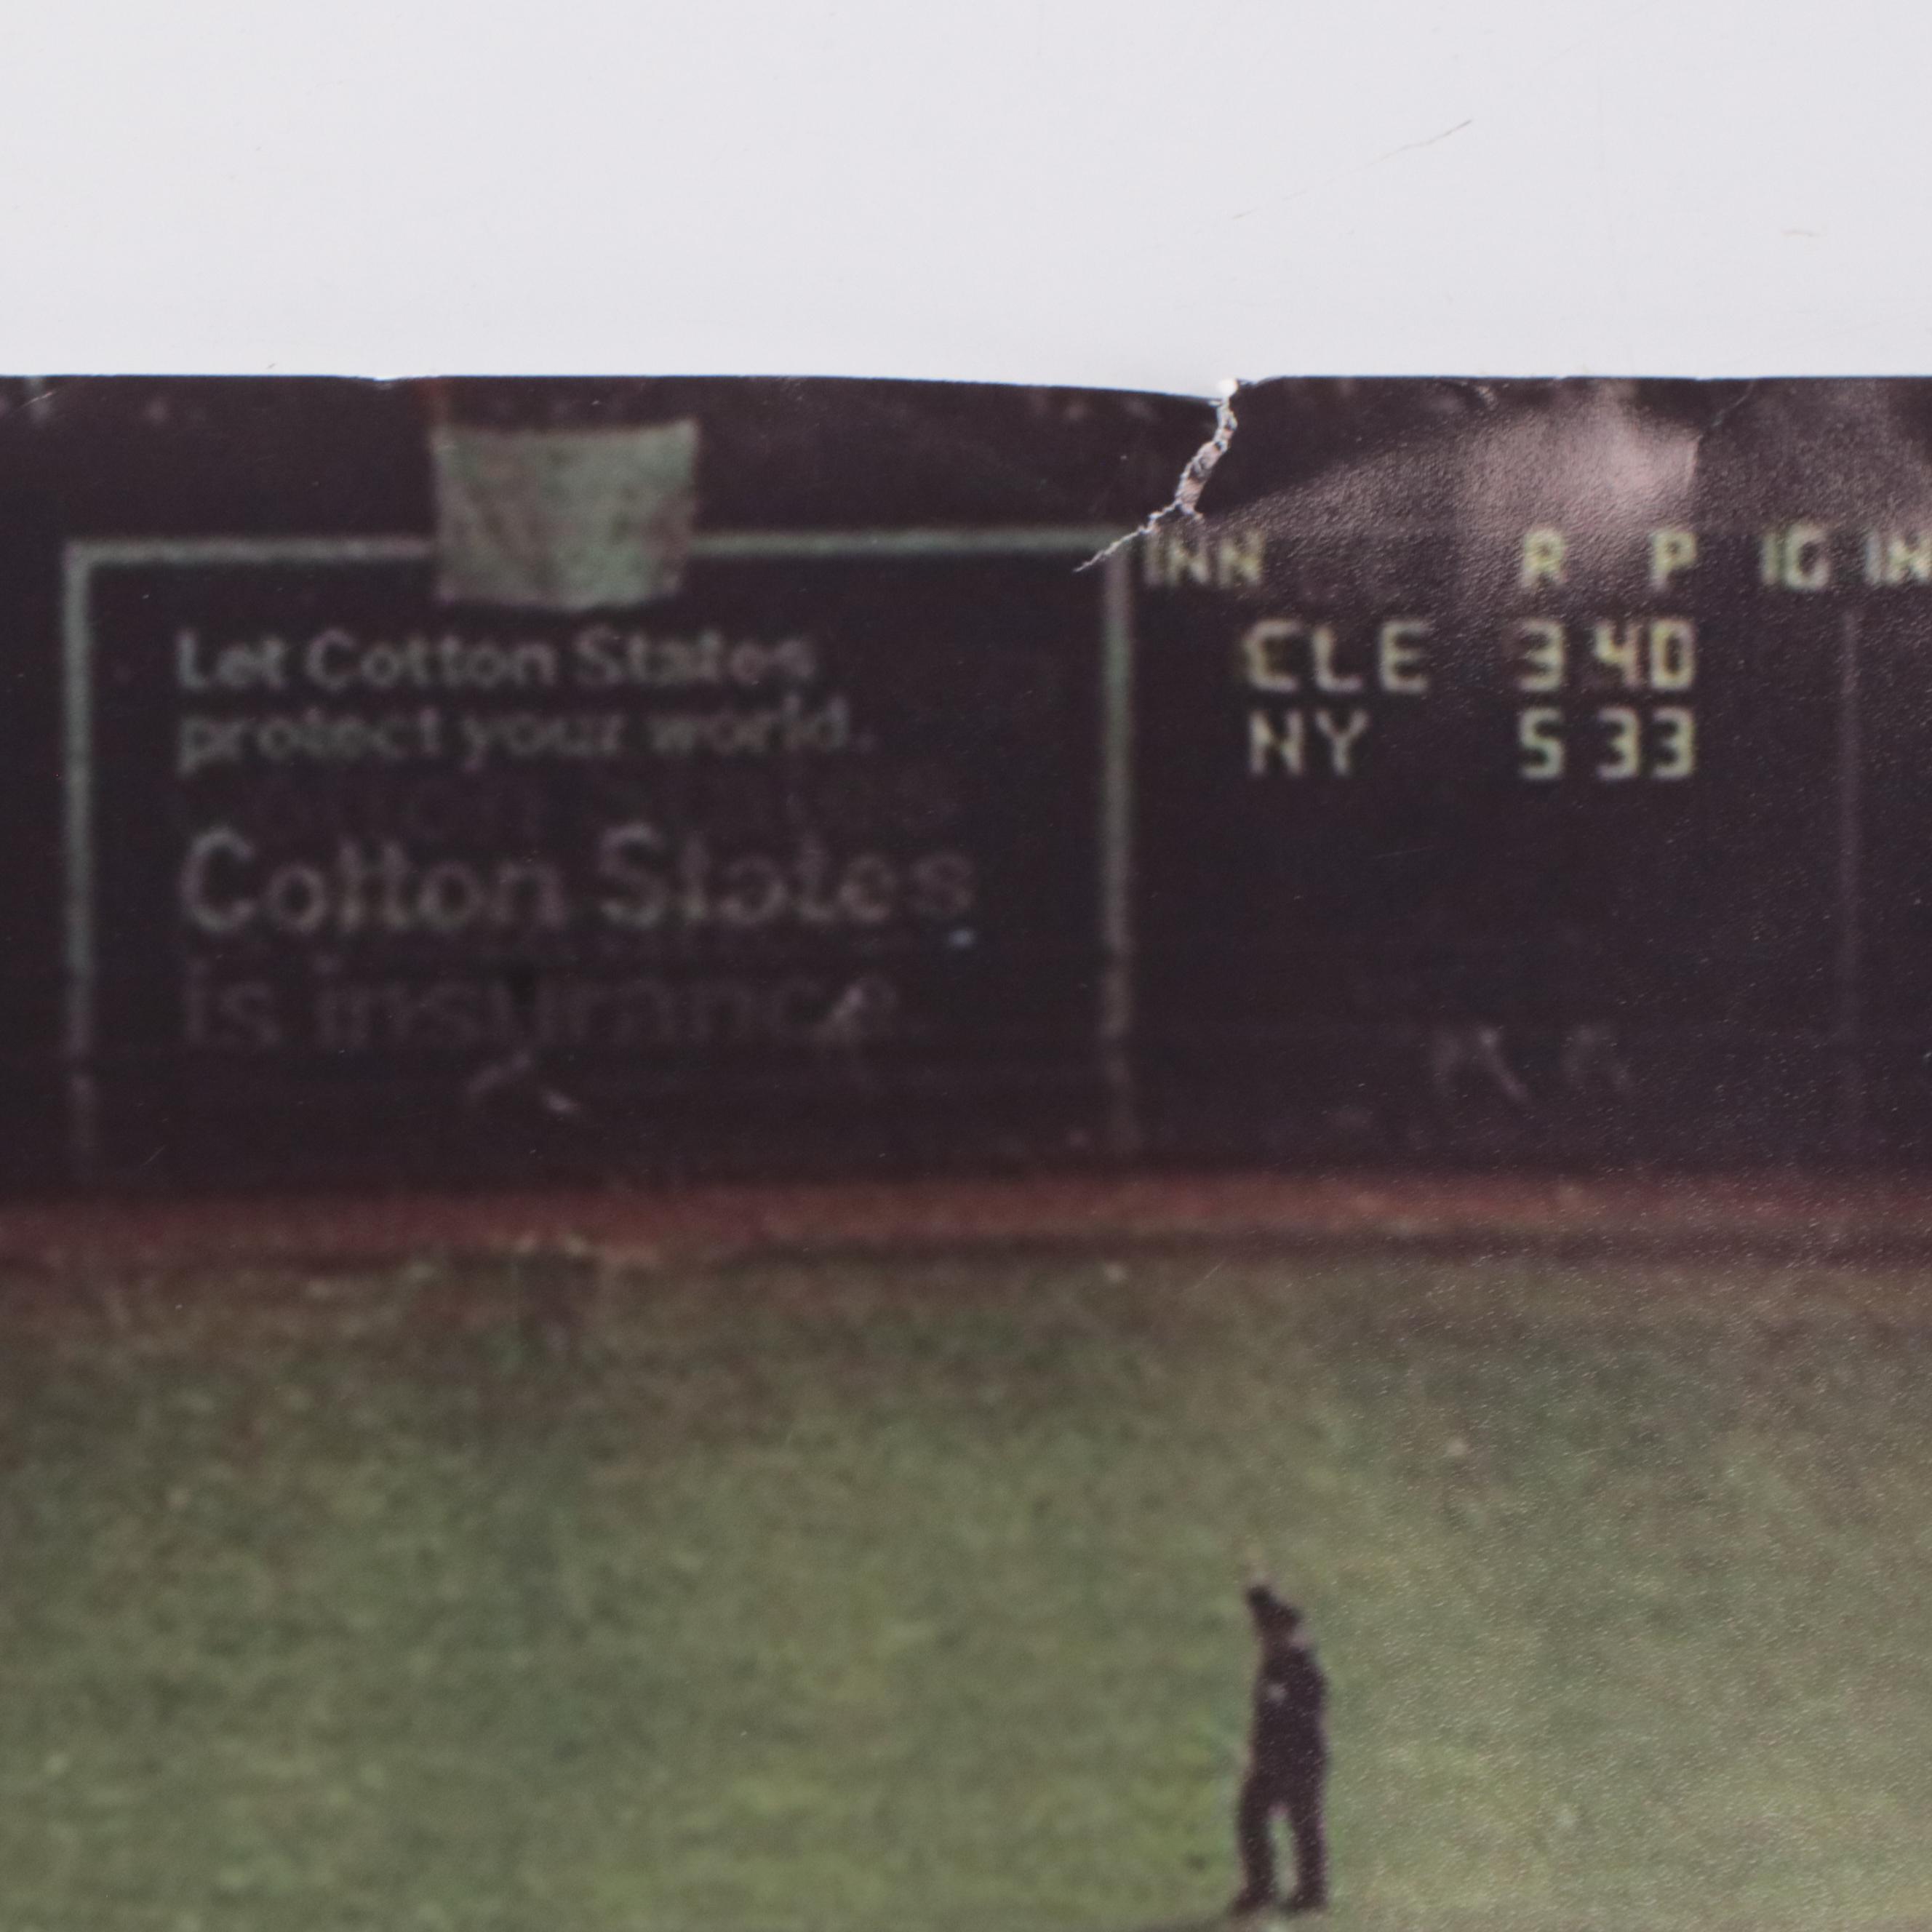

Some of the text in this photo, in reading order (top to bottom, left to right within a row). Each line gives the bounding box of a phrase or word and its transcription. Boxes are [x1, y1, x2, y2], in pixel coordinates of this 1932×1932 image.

[1522, 526, 1566, 586] R
[1650, 529, 1697, 589] P
[177, 627, 816, 690] Let Cotton States
[1245, 618, 1696, 694] CLE 3 40
[177, 693, 874, 775] protect your world.
[1248, 706, 1696, 779] NY 5 33
[178, 822, 978, 933] Cotton States
[183, 957, 281, 1047] is
